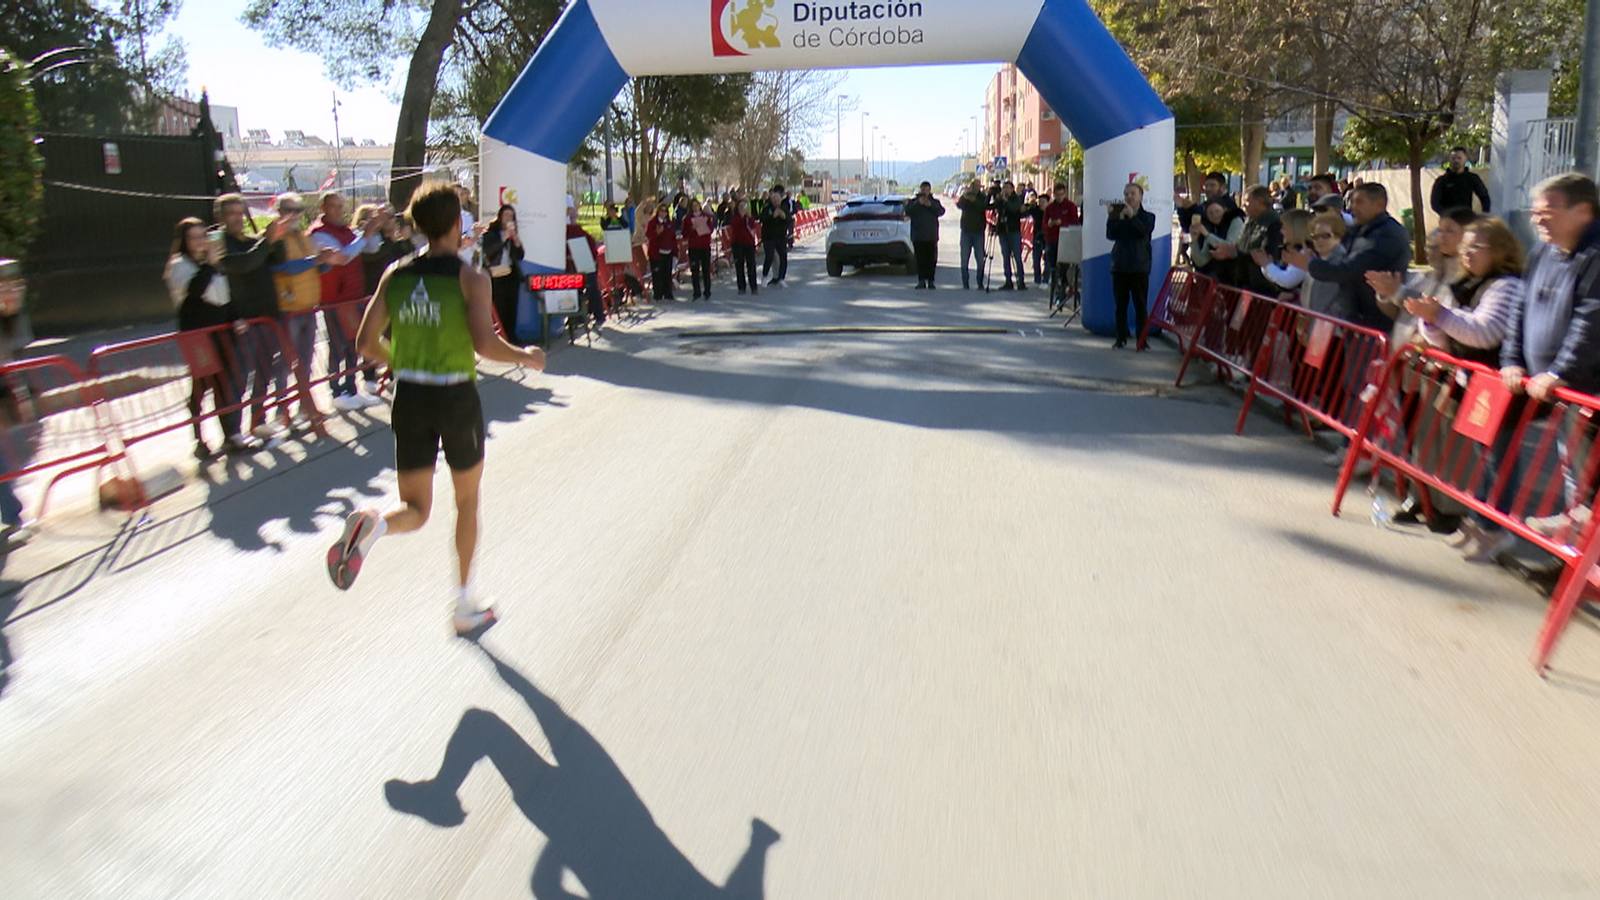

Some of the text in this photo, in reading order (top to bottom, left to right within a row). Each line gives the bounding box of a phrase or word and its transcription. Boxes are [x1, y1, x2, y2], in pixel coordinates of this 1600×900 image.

[793, 0, 922, 26] Diputación
[793, 25, 923, 48] de Córdoba
